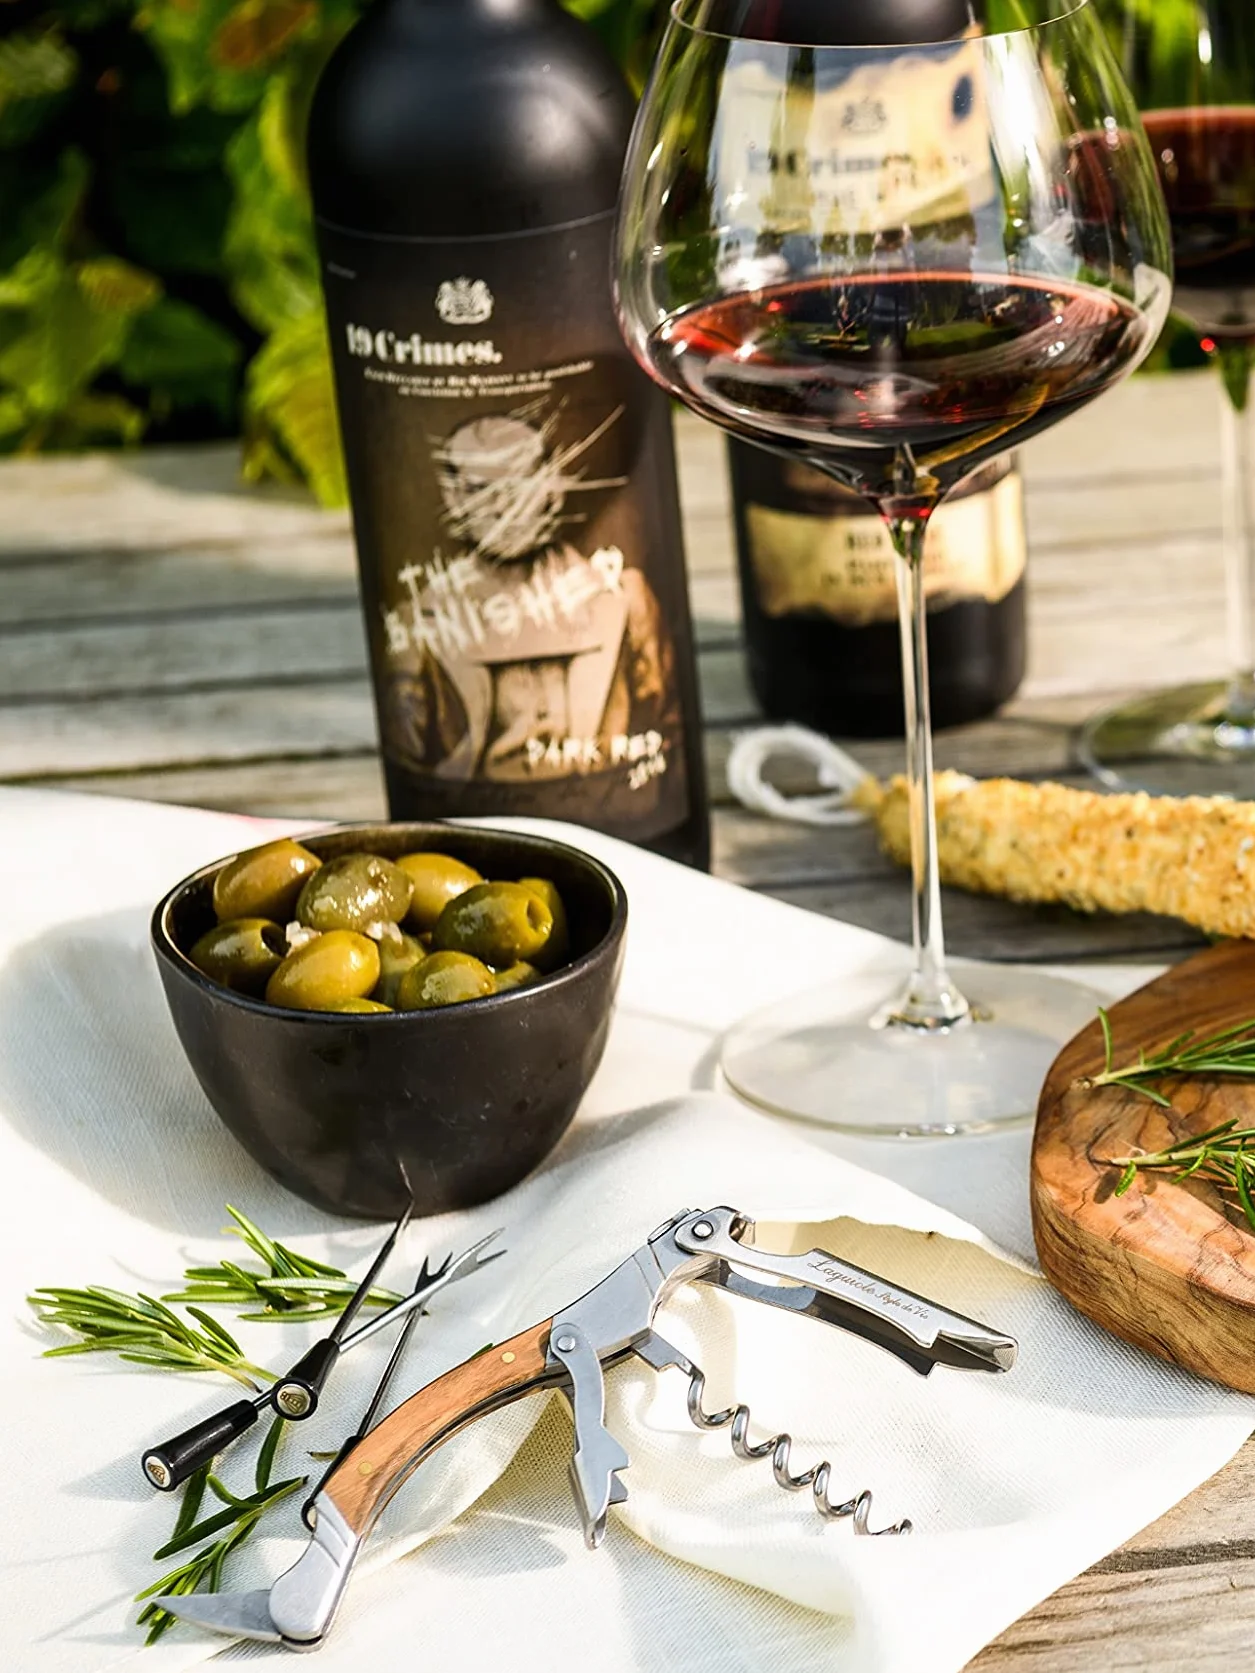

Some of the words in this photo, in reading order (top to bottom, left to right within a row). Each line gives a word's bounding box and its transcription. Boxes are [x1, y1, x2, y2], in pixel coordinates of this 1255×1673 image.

[346, 322, 373, 358] 19
[806, 1259, 877, 1295] Laguiole
[901, 1303, 913, 1313] de
